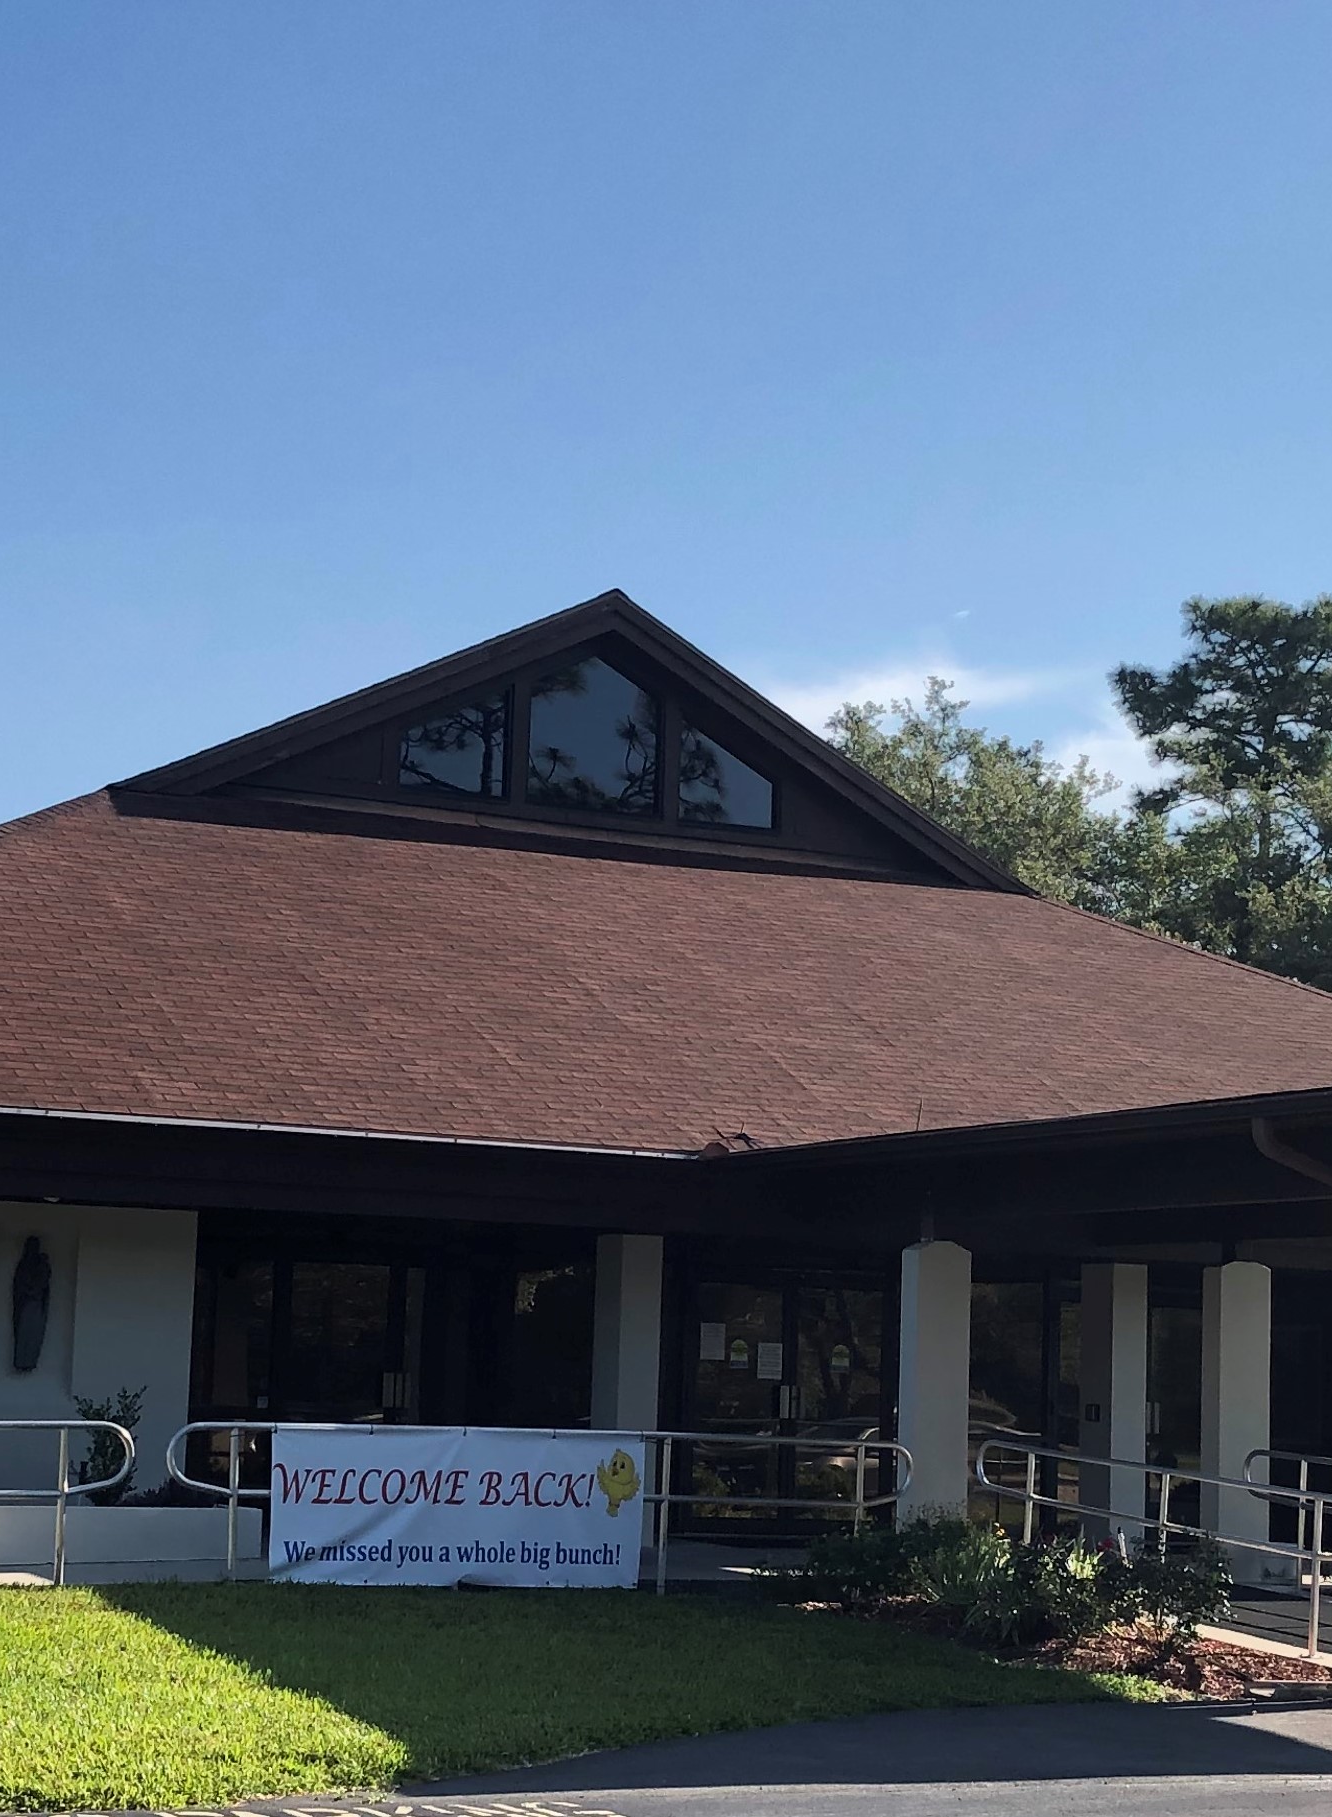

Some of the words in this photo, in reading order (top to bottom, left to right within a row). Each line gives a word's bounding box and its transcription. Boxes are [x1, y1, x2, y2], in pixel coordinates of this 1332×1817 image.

[273, 1463, 468, 1505] WELCOME
[479, 1471, 595, 1508] BACK!
[284, 1541, 315, 1562] We
[319, 1539, 391, 1562] missed
[397, 1543, 433, 1568] you
[438, 1546, 450, 1562] a
[457, 1540, 515, 1563] whole
[520, 1542, 549, 1569] big
[556, 1542, 620, 1565] bunch!
